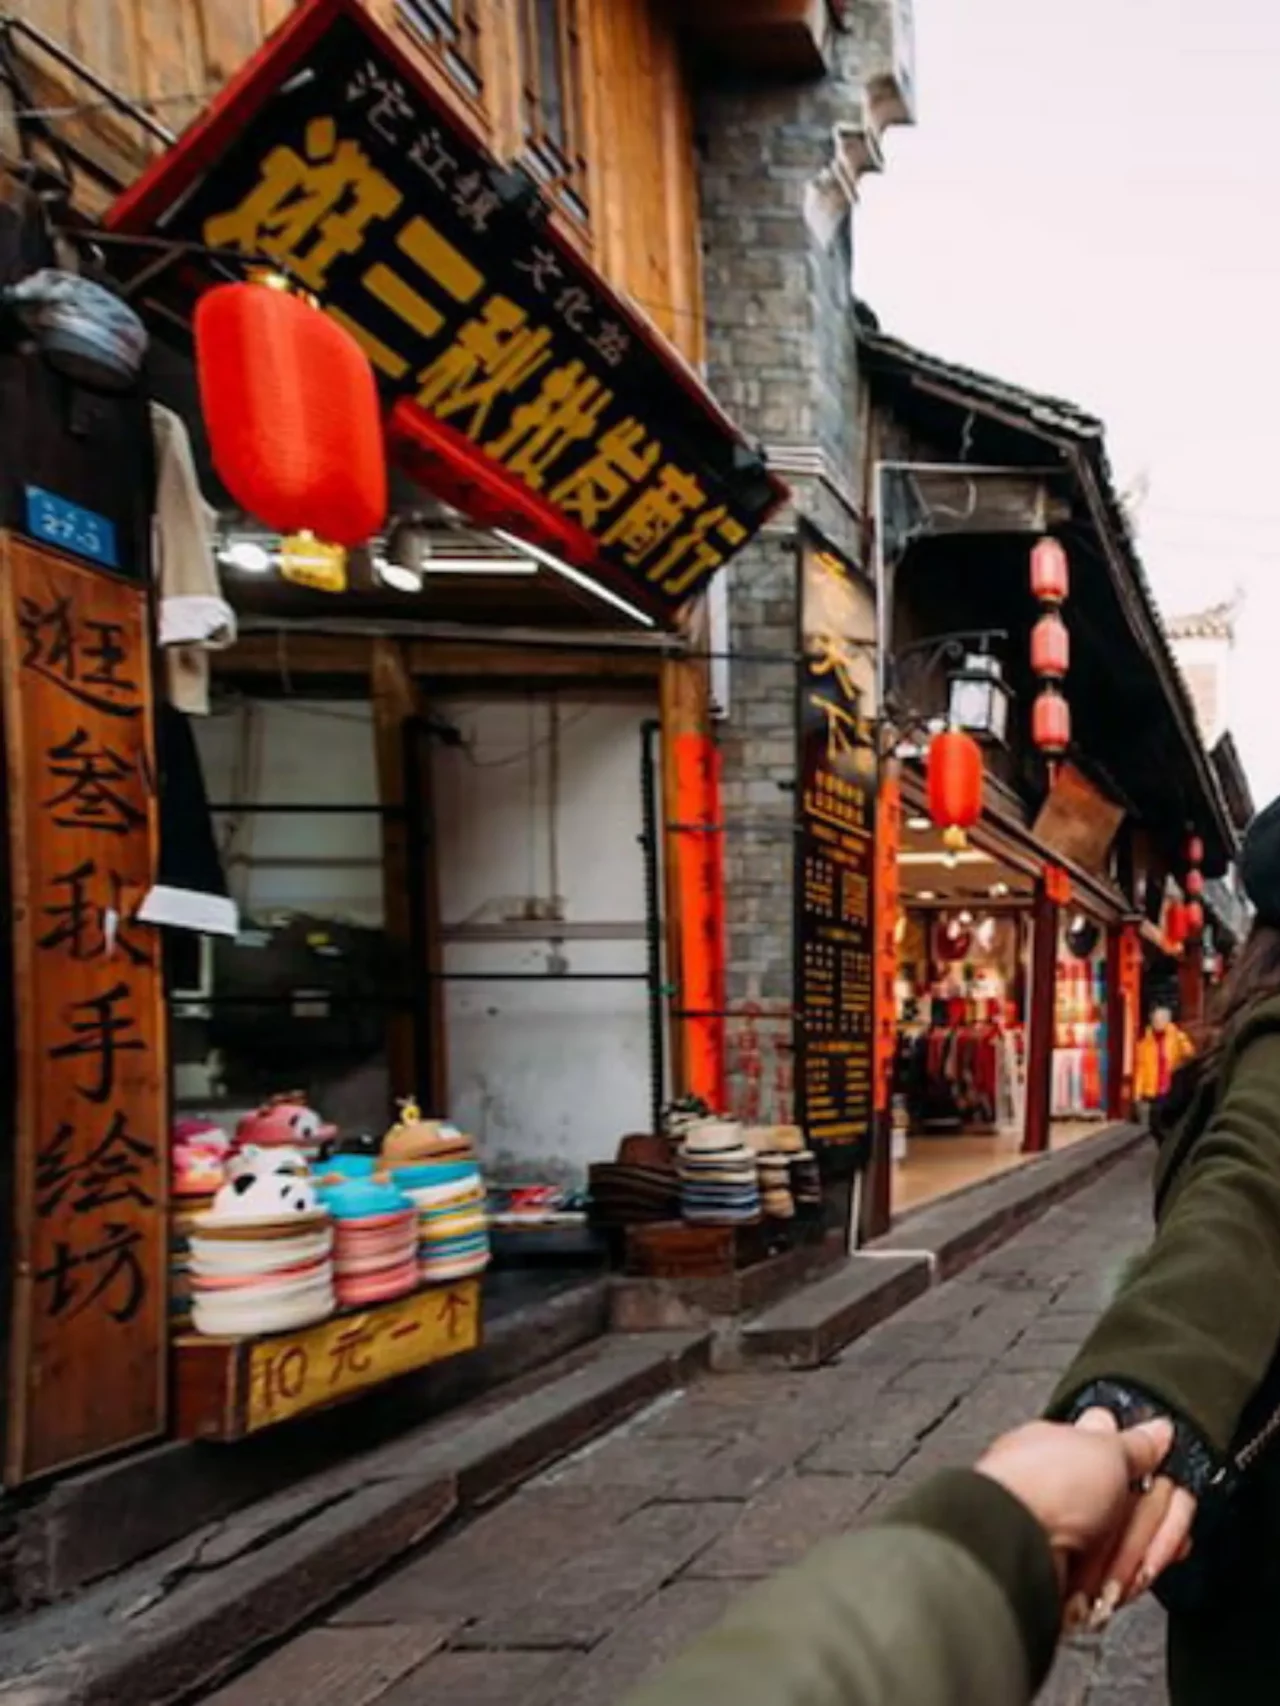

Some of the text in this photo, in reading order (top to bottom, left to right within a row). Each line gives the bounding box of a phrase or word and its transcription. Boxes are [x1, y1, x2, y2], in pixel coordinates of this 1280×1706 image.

[203, 116, 747, 595] 逛三秋批发商行
